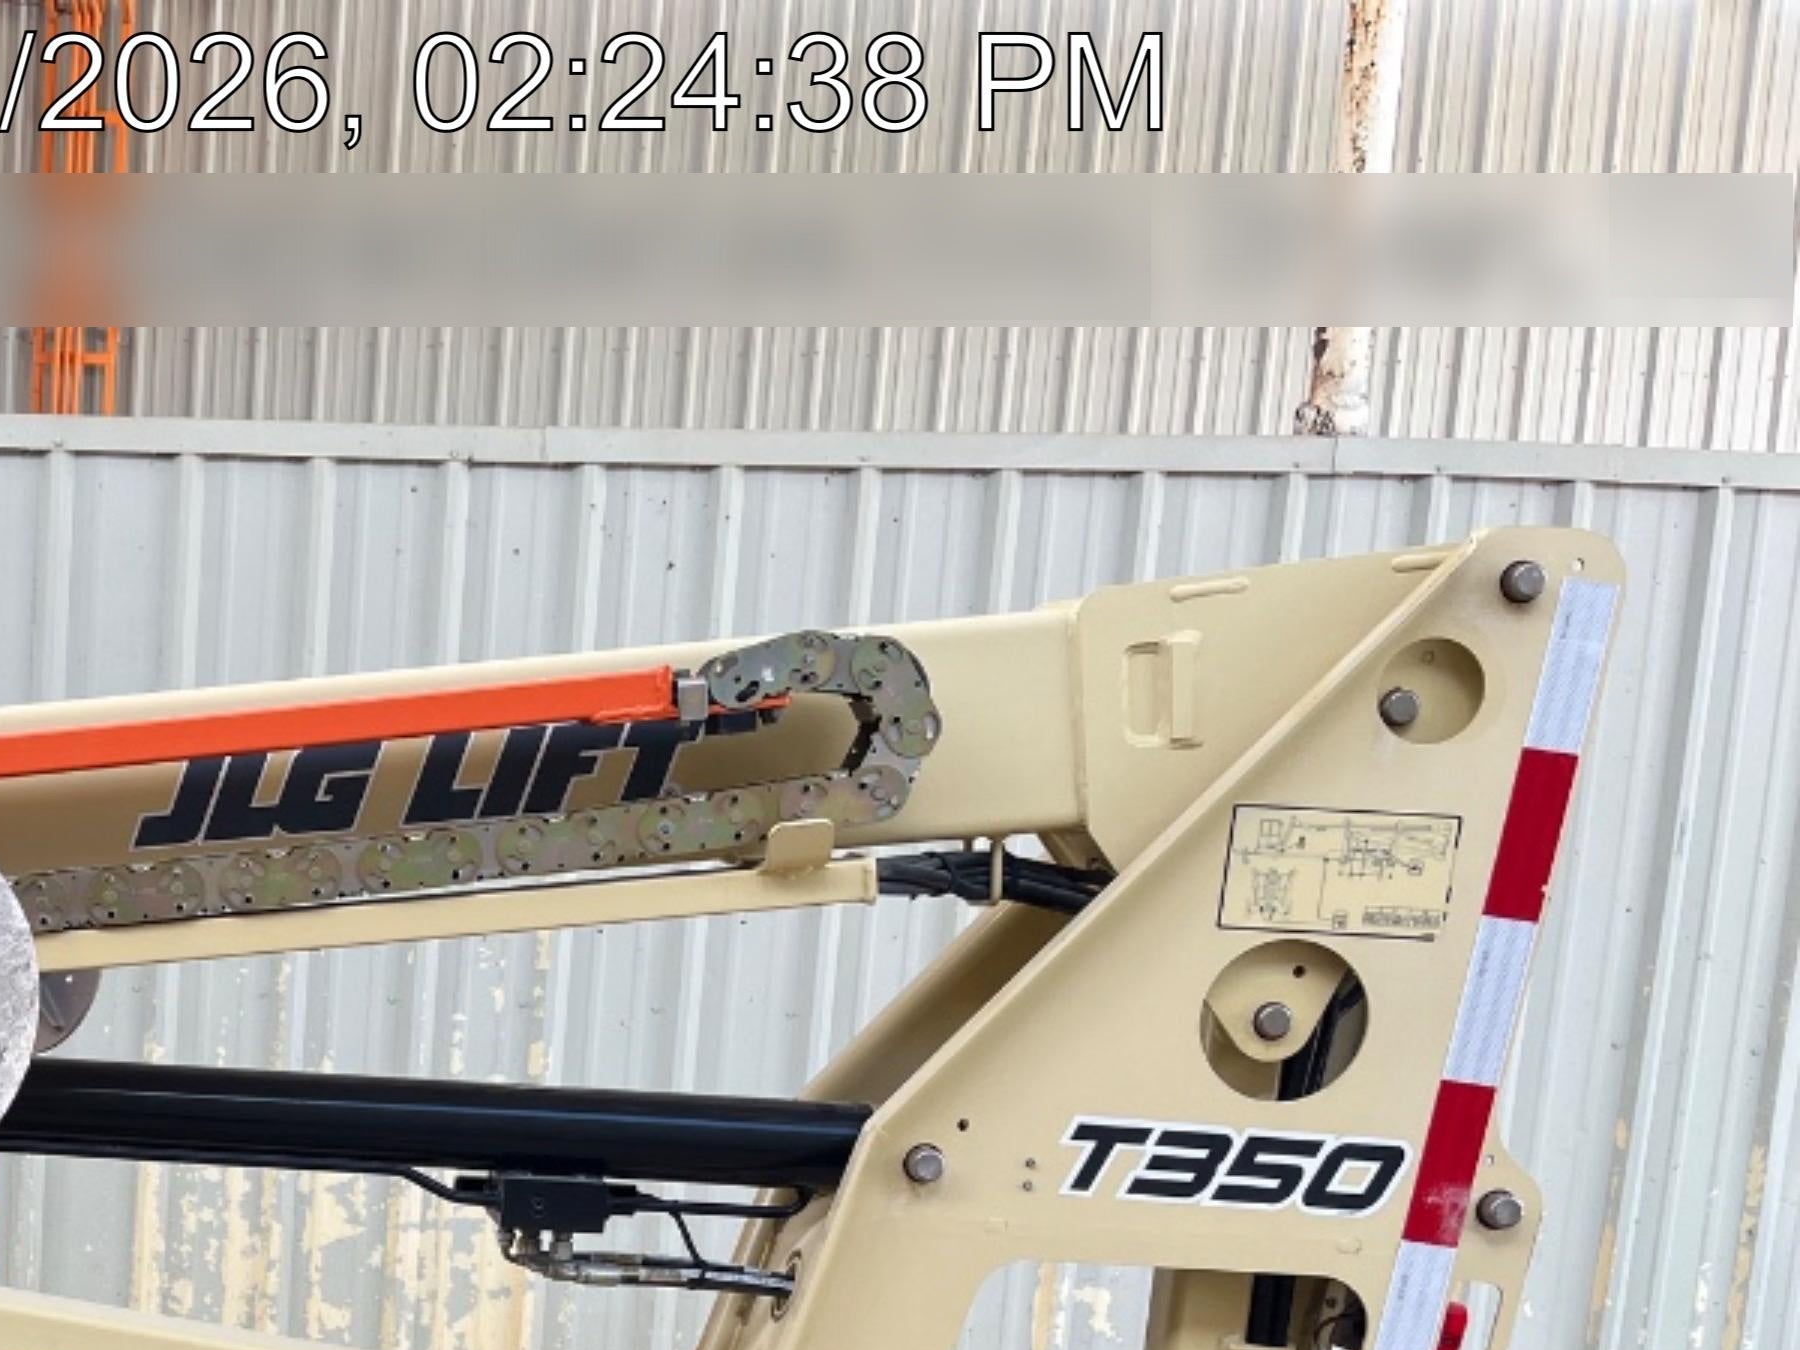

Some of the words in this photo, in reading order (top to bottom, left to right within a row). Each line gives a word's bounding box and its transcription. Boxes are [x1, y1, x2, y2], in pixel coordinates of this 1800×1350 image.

[131, 741, 382, 848] JLG
[401, 722, 700, 825] LIFT
[1069, 1123, 1405, 1211] T350
